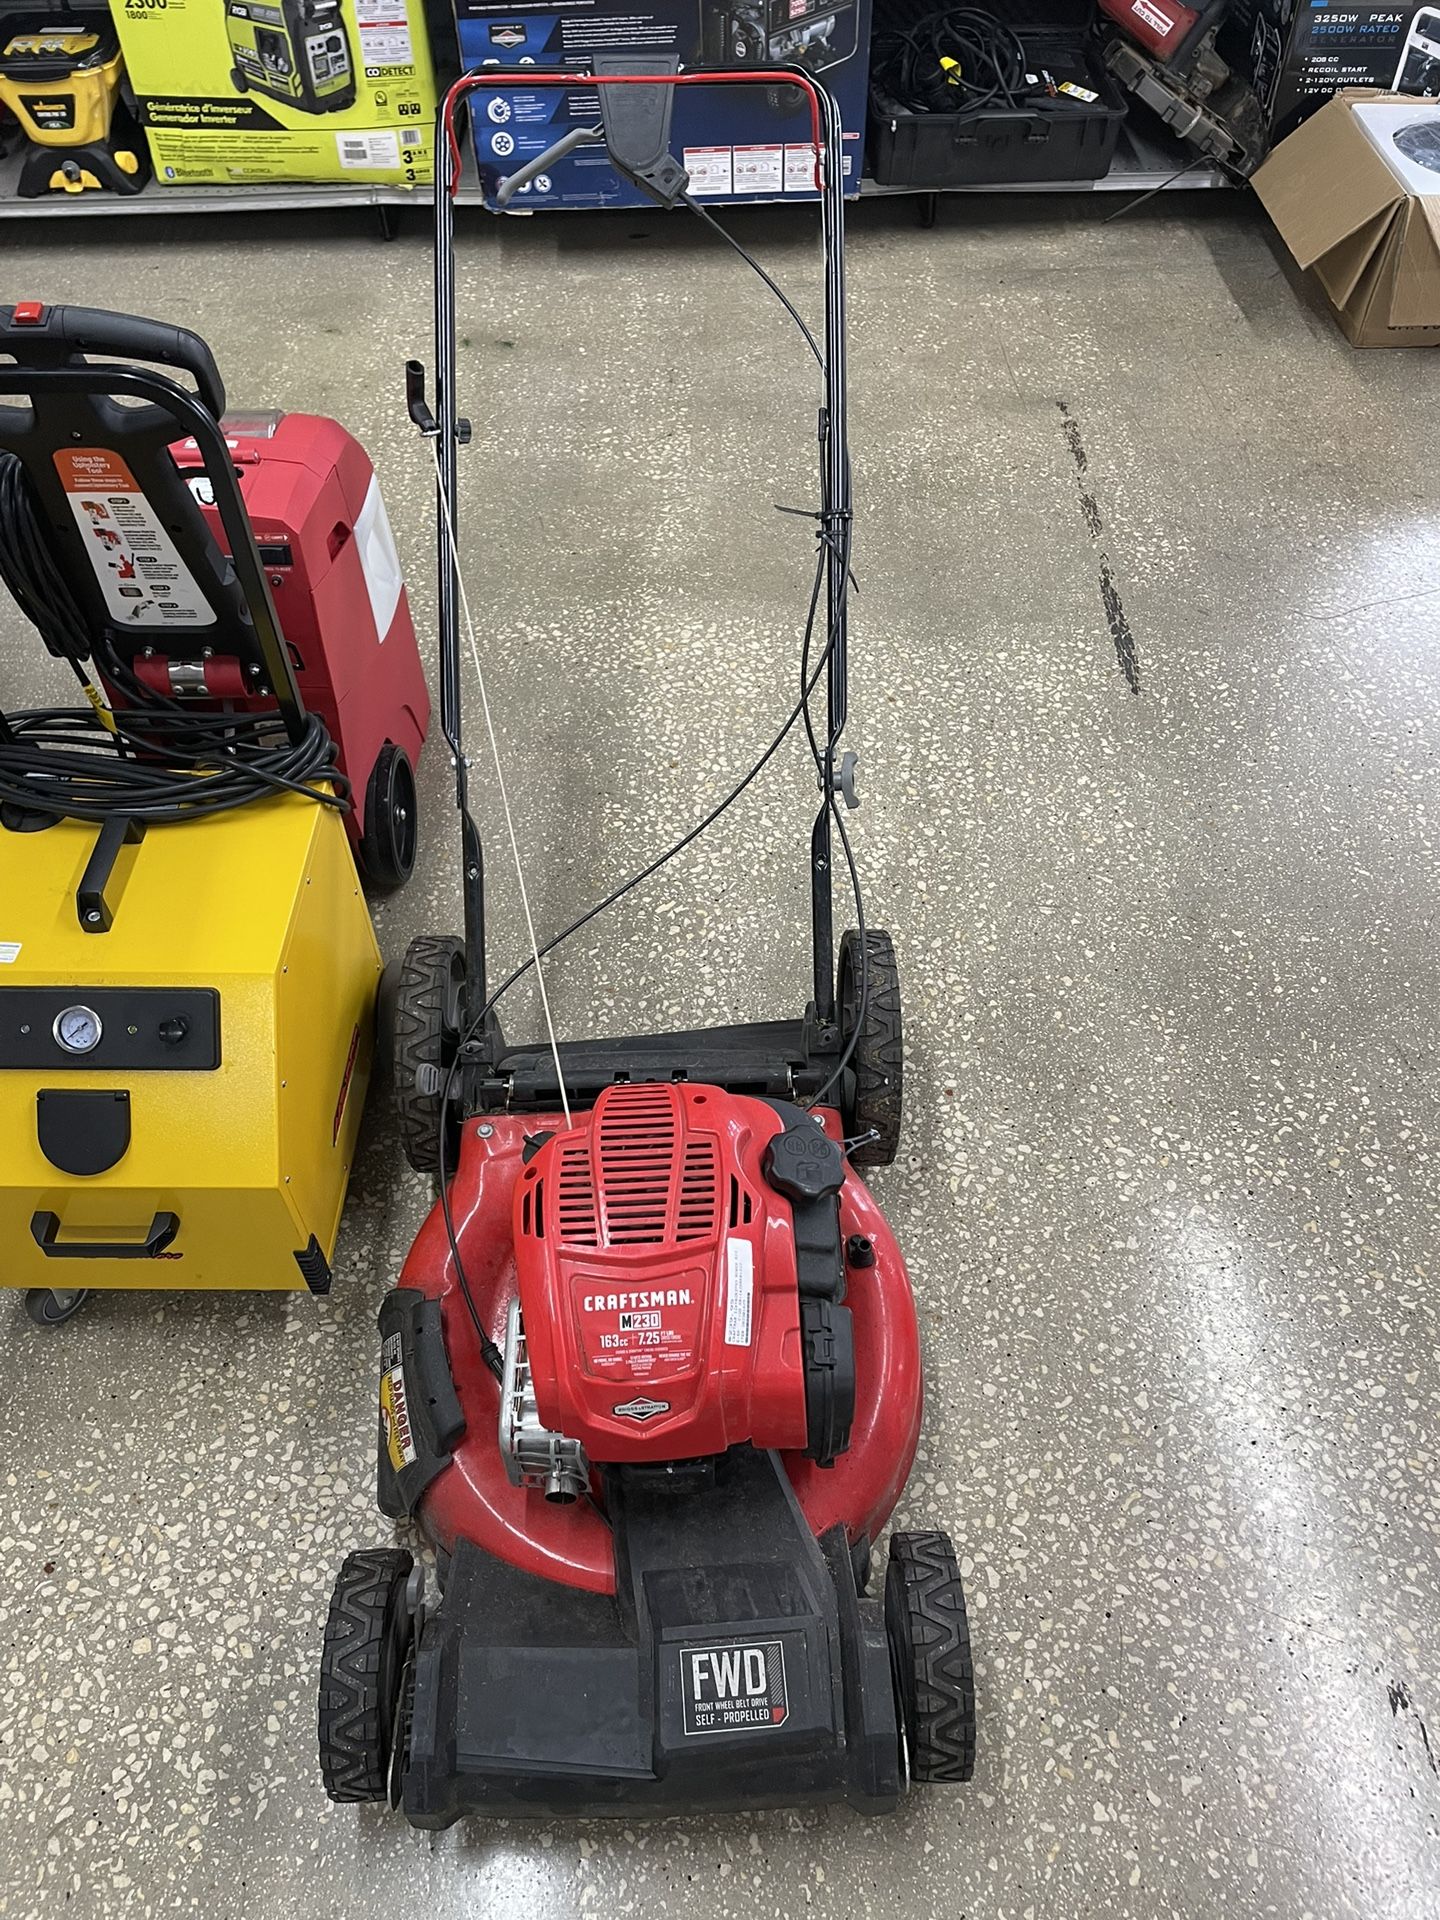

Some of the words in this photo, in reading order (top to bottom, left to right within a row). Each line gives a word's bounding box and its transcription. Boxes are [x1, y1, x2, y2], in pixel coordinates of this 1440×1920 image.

[125, 11, 148, 20] 1800
[1314, 14, 1358, 23] 3250W
[1369, 14, 1403, 22] PEAK
[1312, 25, 1355, 34] 2500W
[1359, 25, 1400, 34] RATED
[366, 68, 380, 77] CO
[381, 66, 414, 76] DETECT
[200, 114, 237, 124] Inverter
[402, 150, 414, 164] 3
[405, 169, 416, 181] 3
[584, 1289, 691, 1312] CRAFTSMAN
[621, 1313, 660, 1329] M230
[638, 1332, 660, 1345] 7.25
[393, 1380, 411, 1450] DANGER
[692, 1649, 766, 1700] FWD
[695, 1702, 714, 1712] FRONT
[715, 1700, 734, 1710] WHEEL
[735, 1699, 749, 1709] BELT
[751, 1697, 768, 1707] DRIVE
[696, 1714, 715, 1726] SELF
[724, 1709, 770, 1723] PROPELLED
